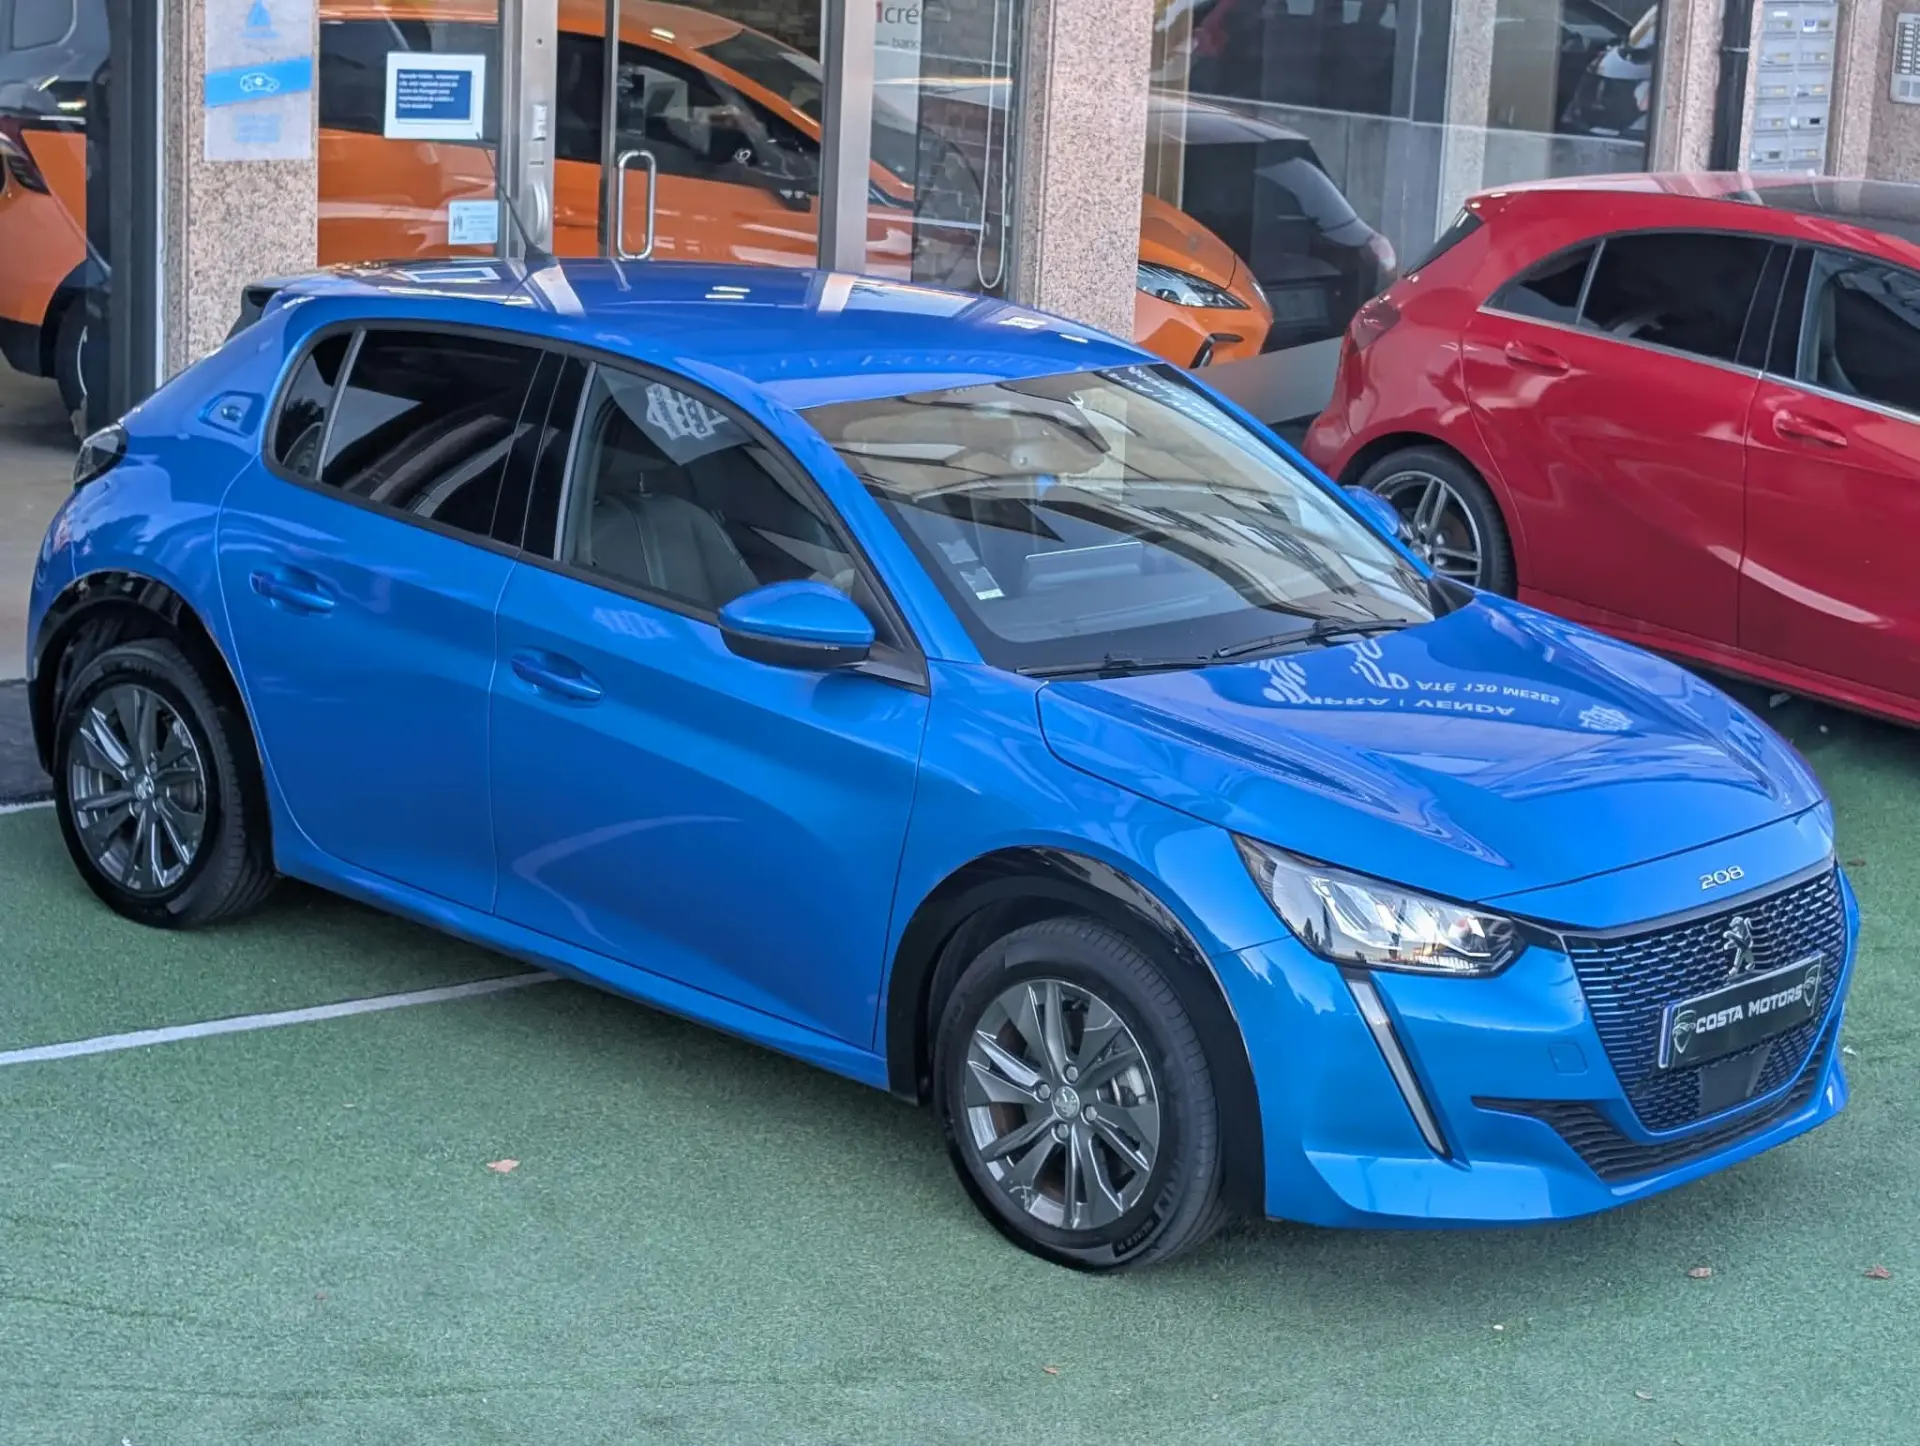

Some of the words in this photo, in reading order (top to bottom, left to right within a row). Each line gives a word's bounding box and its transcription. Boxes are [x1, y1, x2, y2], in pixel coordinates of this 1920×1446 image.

[1699, 865, 1744, 890] 208
[1695, 1005, 1743, 1034] COSTA
[1748, 983, 1803, 1017] MOTORS
